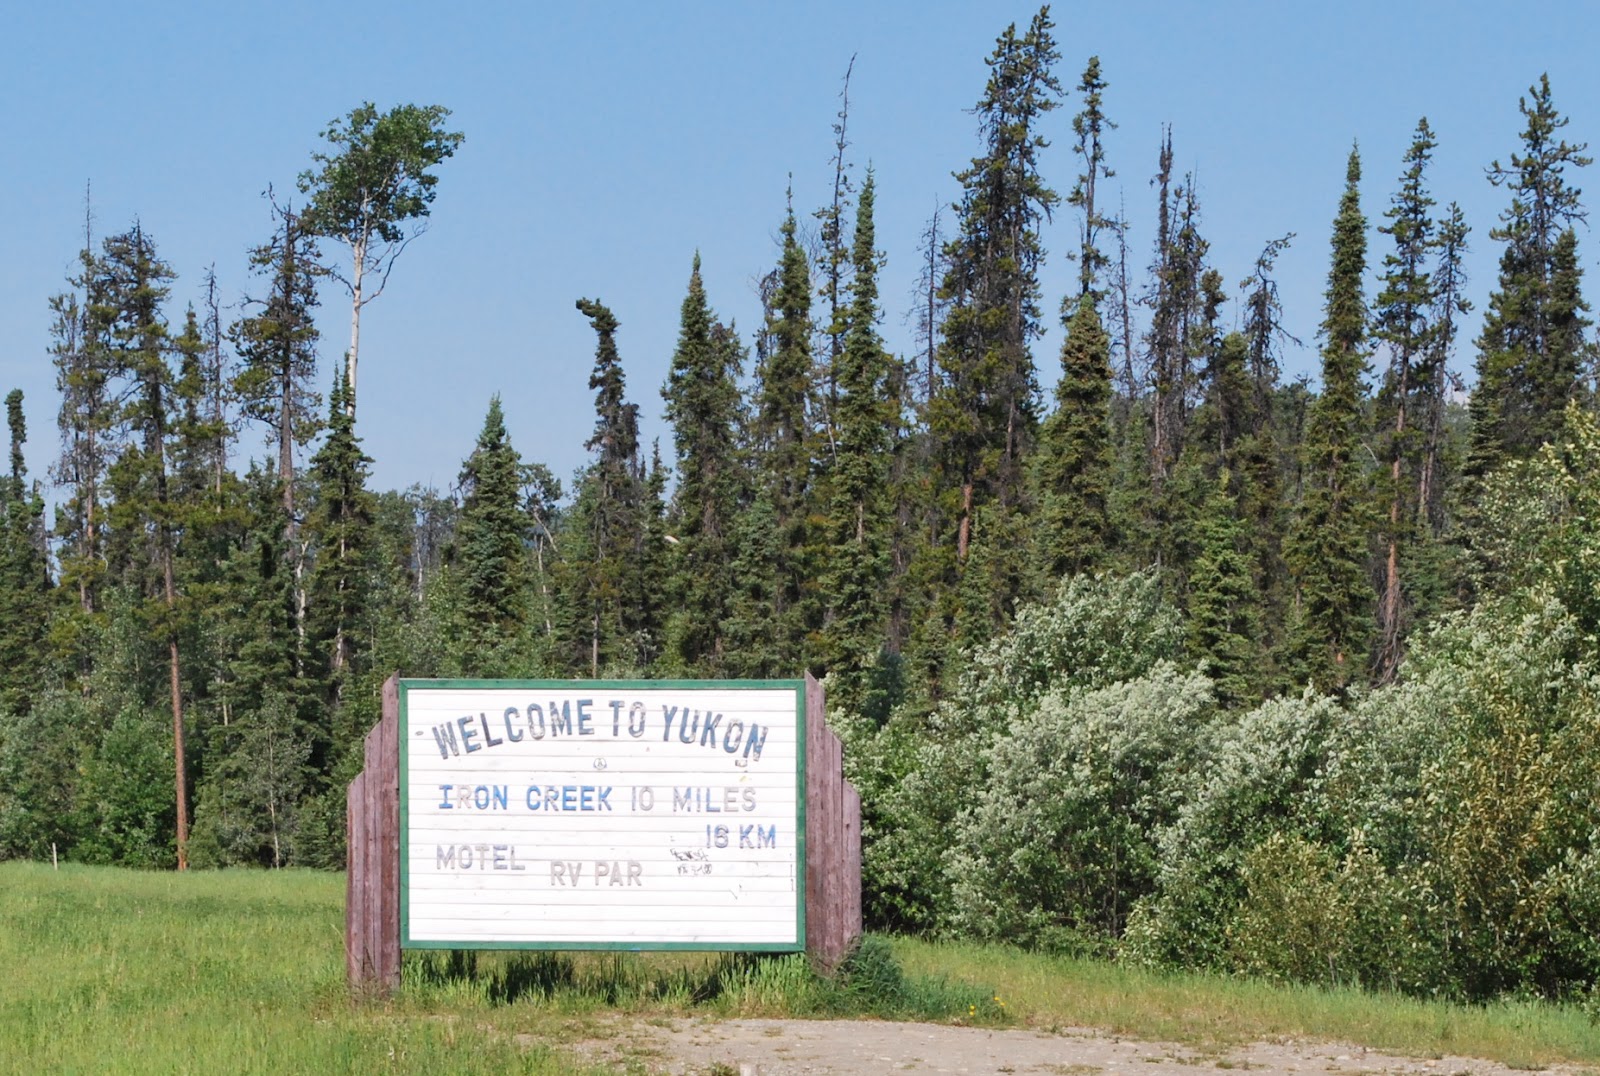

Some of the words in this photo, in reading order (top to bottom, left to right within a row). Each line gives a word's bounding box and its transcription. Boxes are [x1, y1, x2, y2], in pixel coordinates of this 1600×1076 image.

[432, 699, 595, 760] WELCOME
[609, 700, 646, 738] TO
[662, 704, 769, 762] YUKON
[438, 784, 508, 811] IRON
[526, 785, 613, 812] CREEK
[673, 786, 757, 813] MILES
[706, 824, 729, 849] 16
[739, 824, 776, 849] KM
[436, 844, 526, 871] MOTEL
[550, 861, 583, 887] RV
[594, 860, 643, 887] PAR
